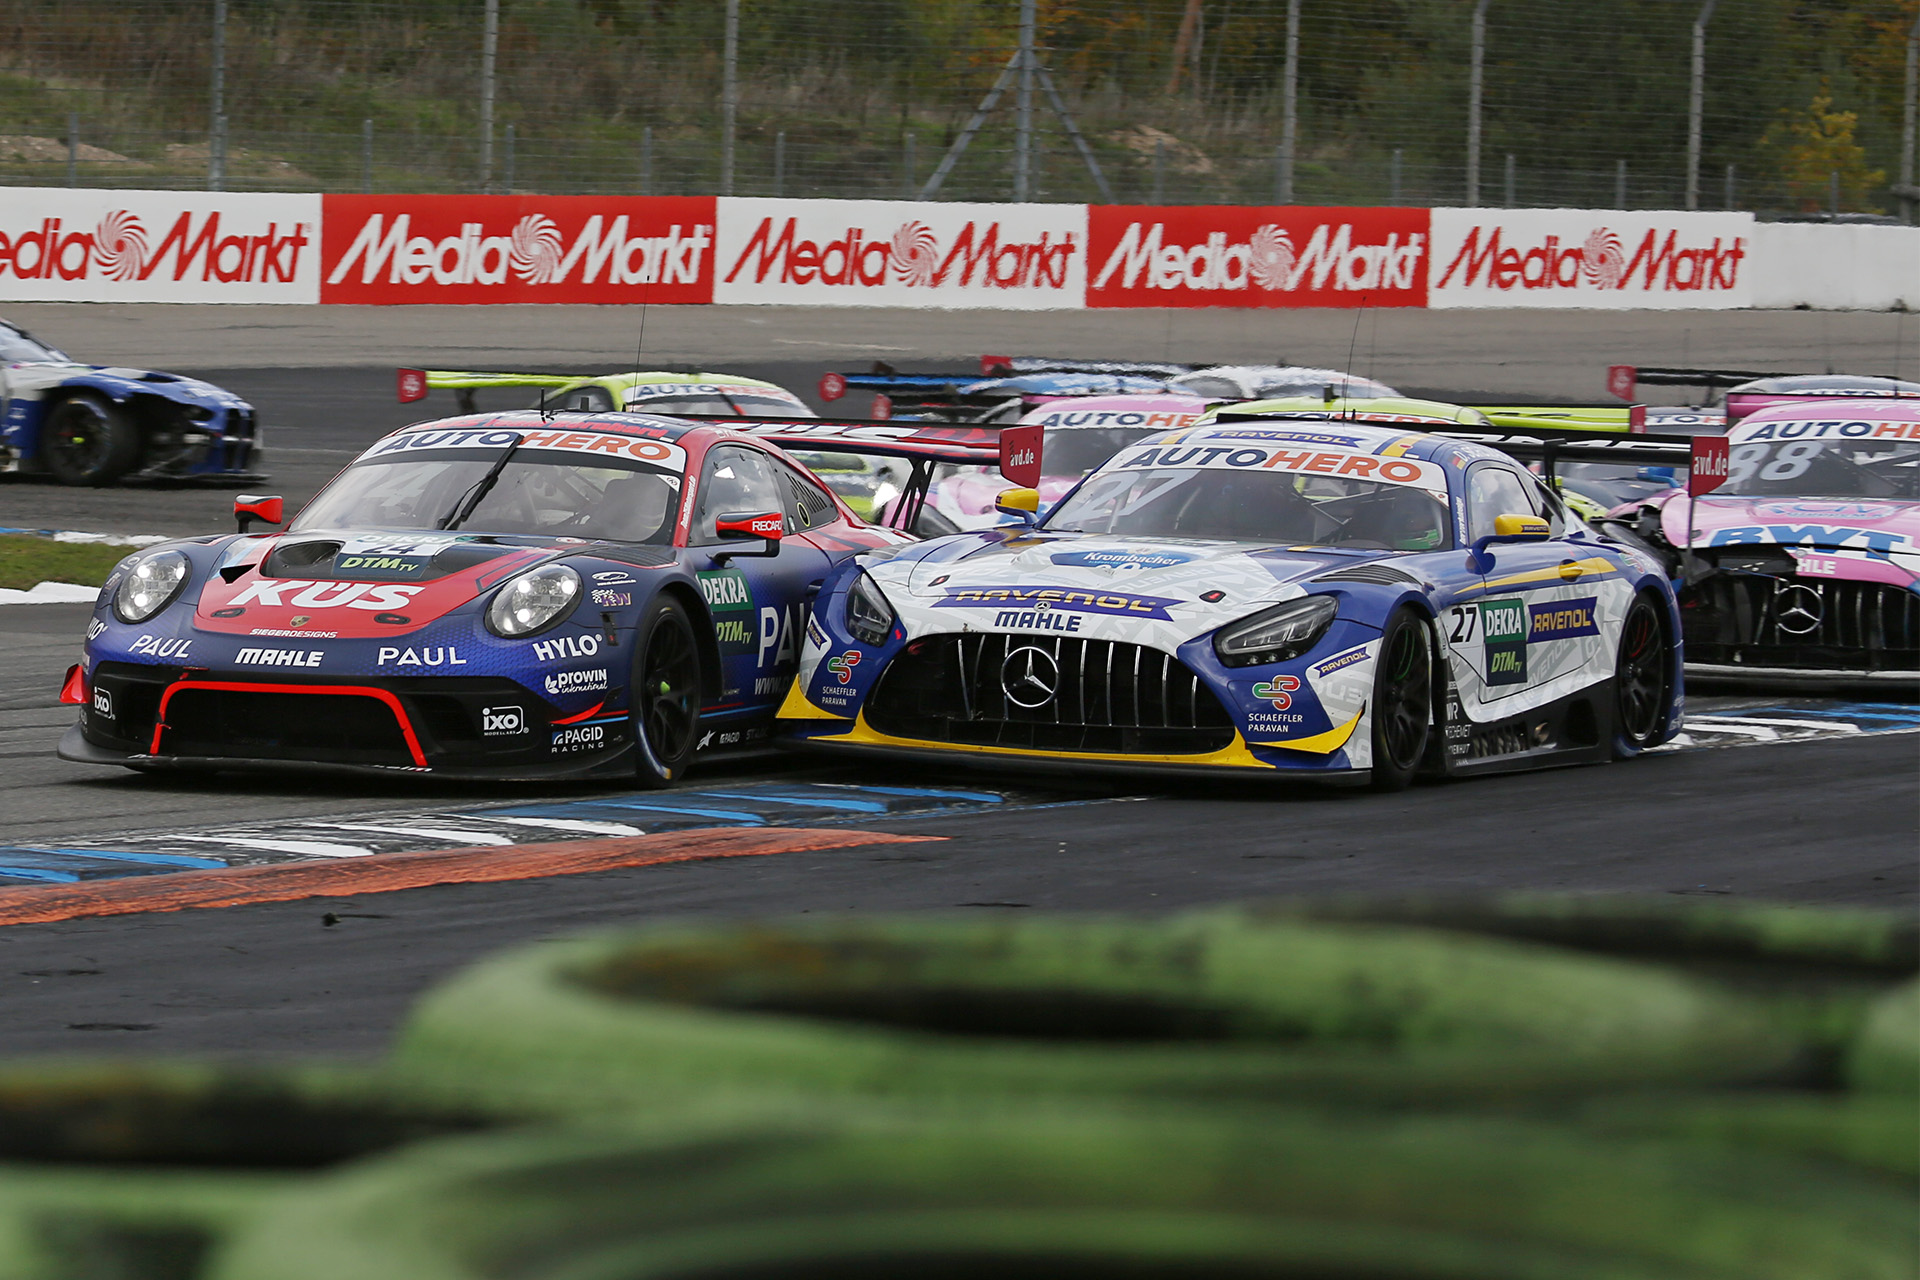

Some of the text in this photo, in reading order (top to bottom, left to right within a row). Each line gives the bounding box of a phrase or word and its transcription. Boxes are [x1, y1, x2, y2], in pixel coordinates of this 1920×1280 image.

[137, 211, 308, 283] Markt
[326, 213, 710, 285] Media Markt
[723, 217, 1076, 289] Media Markt
[1092, 222, 1424, 290] Media Markt
[1436, 226, 1746, 291] Media Markt
[373, 431, 671, 461] AUTOHERO
[1219, 430, 1349, 444] RAVENOL
[1010, 448, 1035, 467] avd.de
[1119, 447, 1422, 483] AUTOHERO
[1693, 449, 1728, 476] avd.de
[1076, 469, 1202, 520] 27
[1711, 524, 1905, 560] BWT
[1083, 552, 1181, 565] Krombacher
[701, 576, 748, 605] DEKRA
[956, 590, 1154, 612] RAVENOL
[994, 611, 1082, 632] MAHLE
[1450, 606, 1477, 644] 27
[1486, 607, 1522, 637] DEKRA
[1533, 609, 1592, 633] RAVENOL
[128, 634, 193, 659] PAUL
[235, 647, 325, 668] MAHLE
[377, 646, 467, 666] PAUL
[532, 635, 598, 661] HYLO
[1321, 651, 1366, 674] RAVENOL
[821, 696, 847, 706] PARAVAN
[822, 686, 857, 697] SCHAEFFLER
[1247, 723, 1289, 733] PARAVAN
[1248, 712, 1303, 723] SCHAEFFLER
[565, 725, 604, 744] PAGID
[551, 741, 605, 754] RACING
